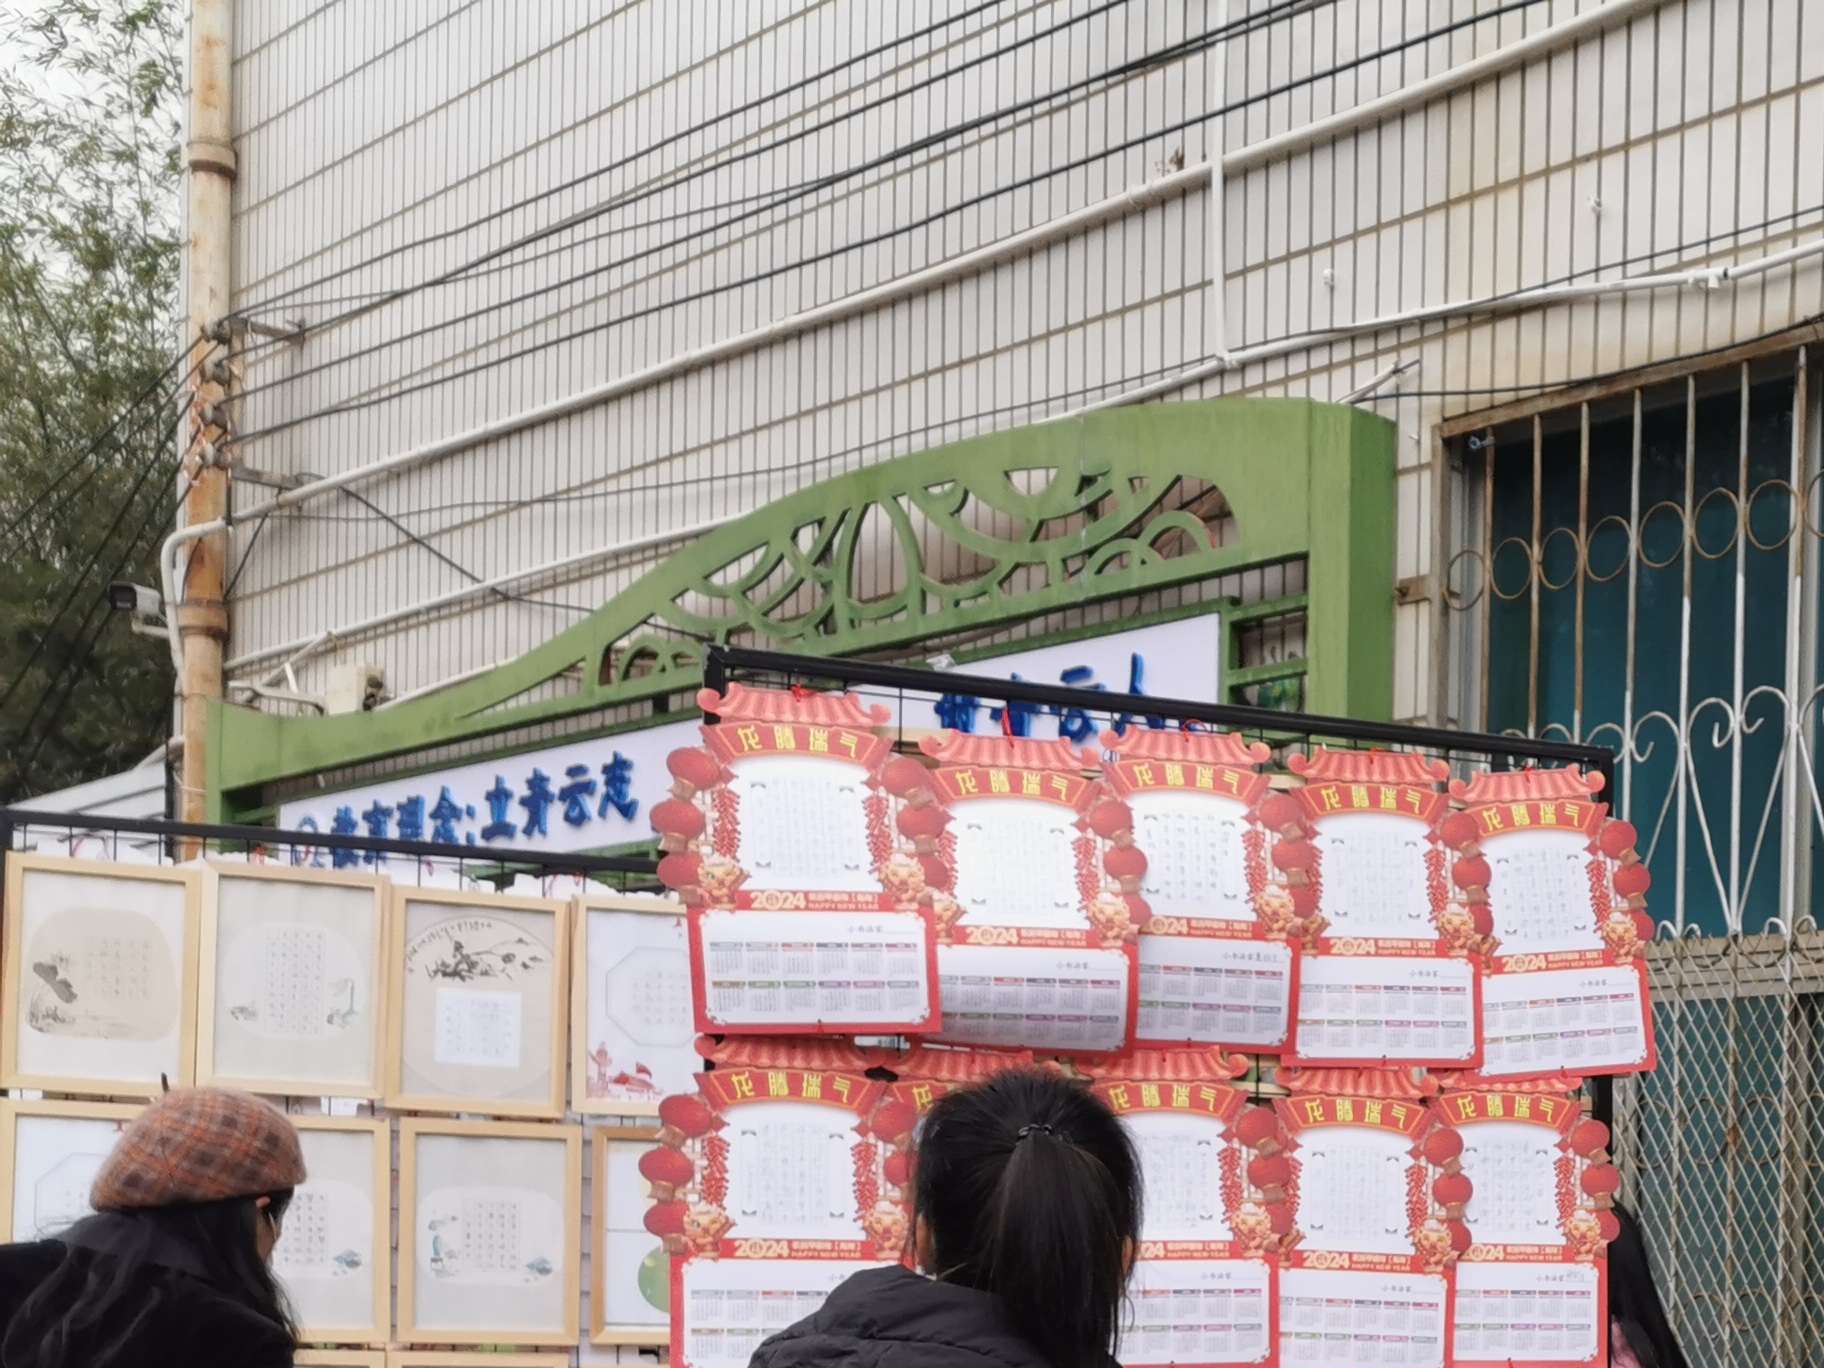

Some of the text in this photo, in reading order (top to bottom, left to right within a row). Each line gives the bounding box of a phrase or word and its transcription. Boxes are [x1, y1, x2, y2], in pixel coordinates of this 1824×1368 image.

[737, 728, 857, 758] 龙腾瑞气
[955, 773, 1068, 800] 龙腾瑞气
[1132, 764, 1240, 794] 龙腾瑞气
[1321, 786, 1421, 814] 龙腾瑞气
[1483, 802, 1580, 829] 龙腾瑞气
[751, 891, 806, 910] 2024
[967, 926, 1017, 943] 2024
[1330, 938, 1375, 955] 2024
[1503, 954, 1546, 971] 2024
[731, 1071, 851, 1103] 龙腾瑞气
[1108, 1083, 1216, 1112] 龙腾瑞气
[1305, 1103, 1406, 1128] 龙腾瑞气
[1457, 1093, 1555, 1123] 龙腾瑞气
[734, 1240, 789, 1258] 2024
[1304, 1251, 1350, 1269] 2024
